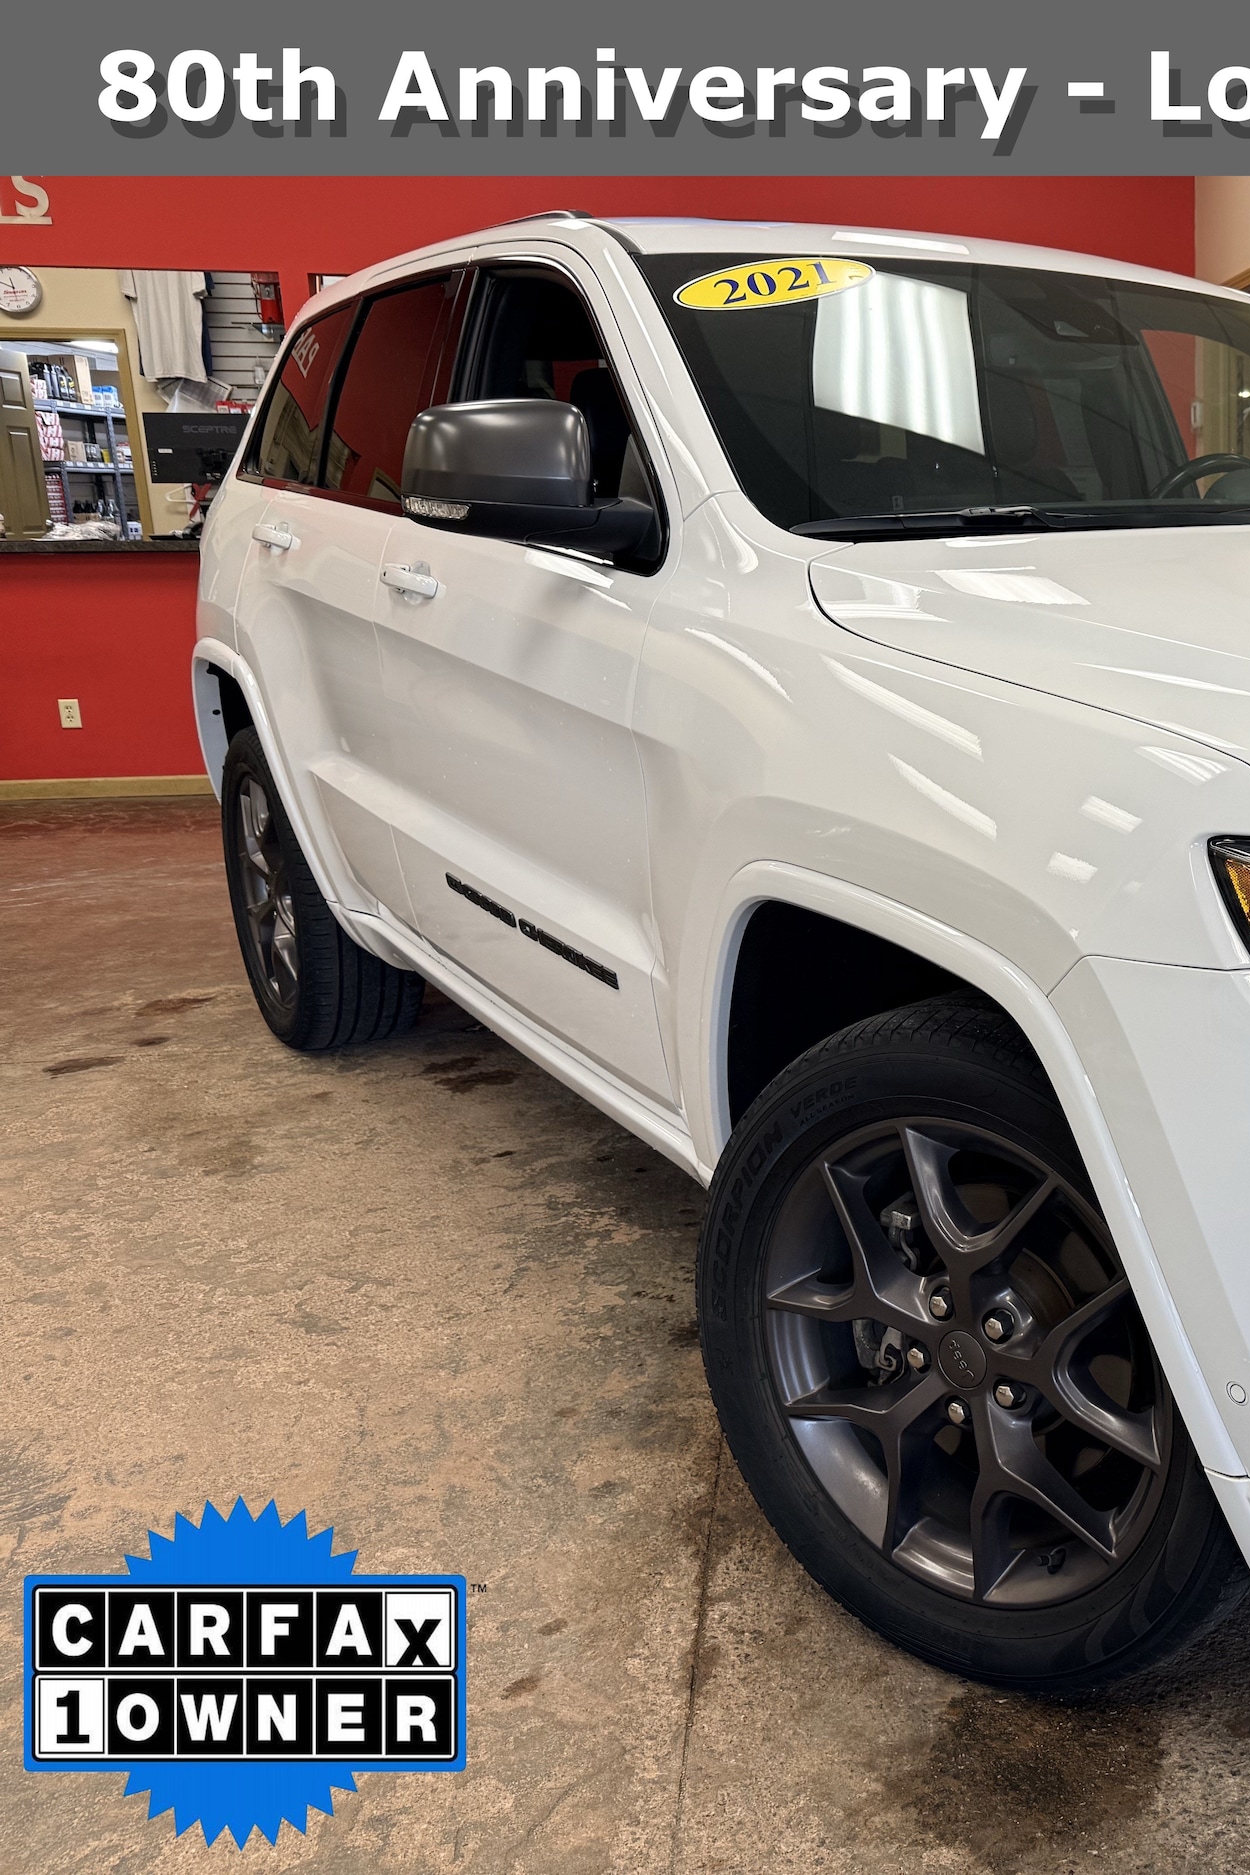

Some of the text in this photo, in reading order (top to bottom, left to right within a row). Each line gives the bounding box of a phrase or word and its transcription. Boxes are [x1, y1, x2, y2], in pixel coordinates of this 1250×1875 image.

[713, 261, 837, 305] 2021
[182, 425, 237, 434] SCEPTRE
[711, 1076, 858, 1321] SCORPION VERDE
